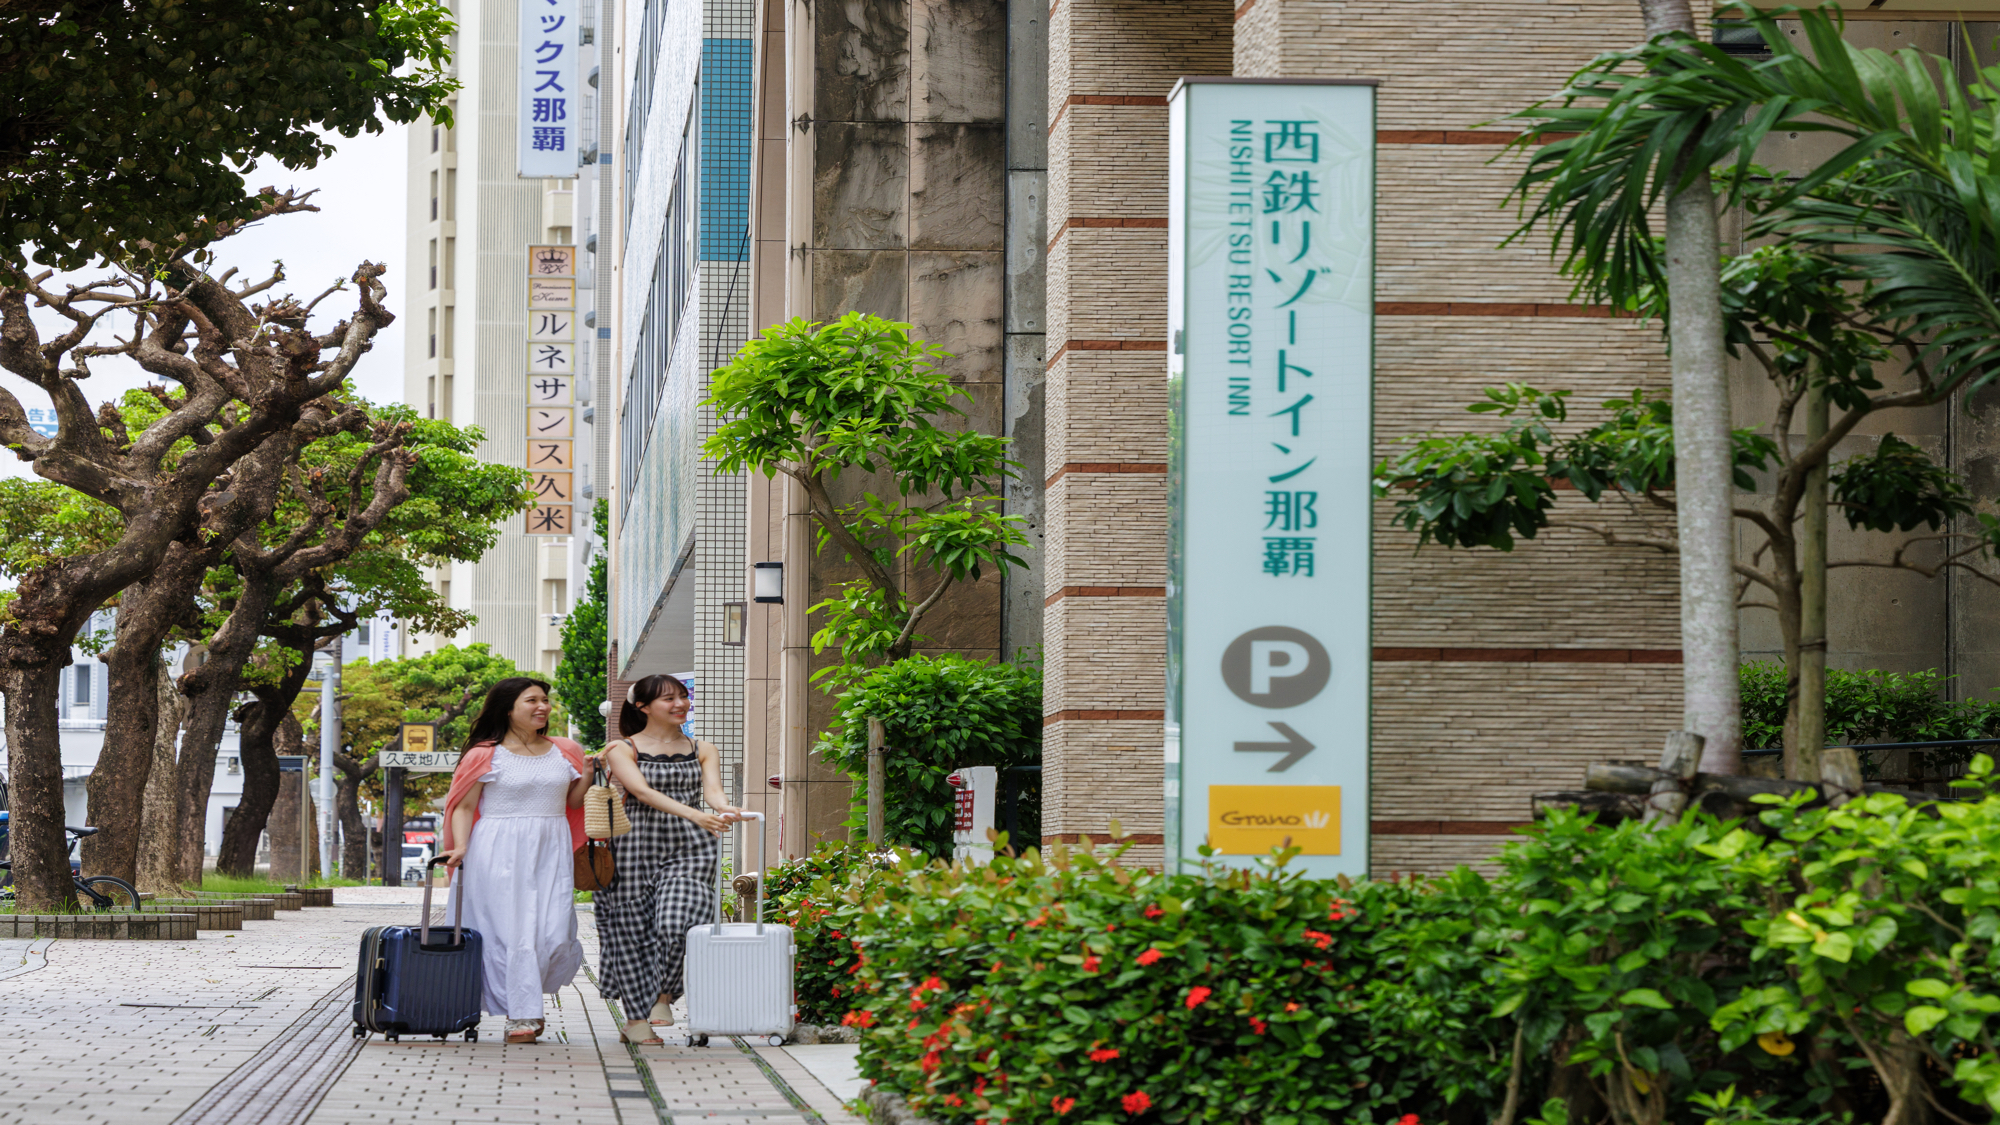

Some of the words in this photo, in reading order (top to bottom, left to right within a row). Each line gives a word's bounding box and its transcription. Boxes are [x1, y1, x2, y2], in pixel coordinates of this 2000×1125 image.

[532, 0, 566, 151] ックス那覇
[1227, 119, 1253, 265] NISHITETSU
[1227, 274, 1252, 368] RESORT
[1262, 120, 1331, 577] 西鉄リゾートイン那覇
[532, 313, 568, 531] ルネサンス久米
[1227, 376, 1251, 416] INN
[1250, 640, 1309, 694] P
[1220, 811, 1302, 827] Grano
